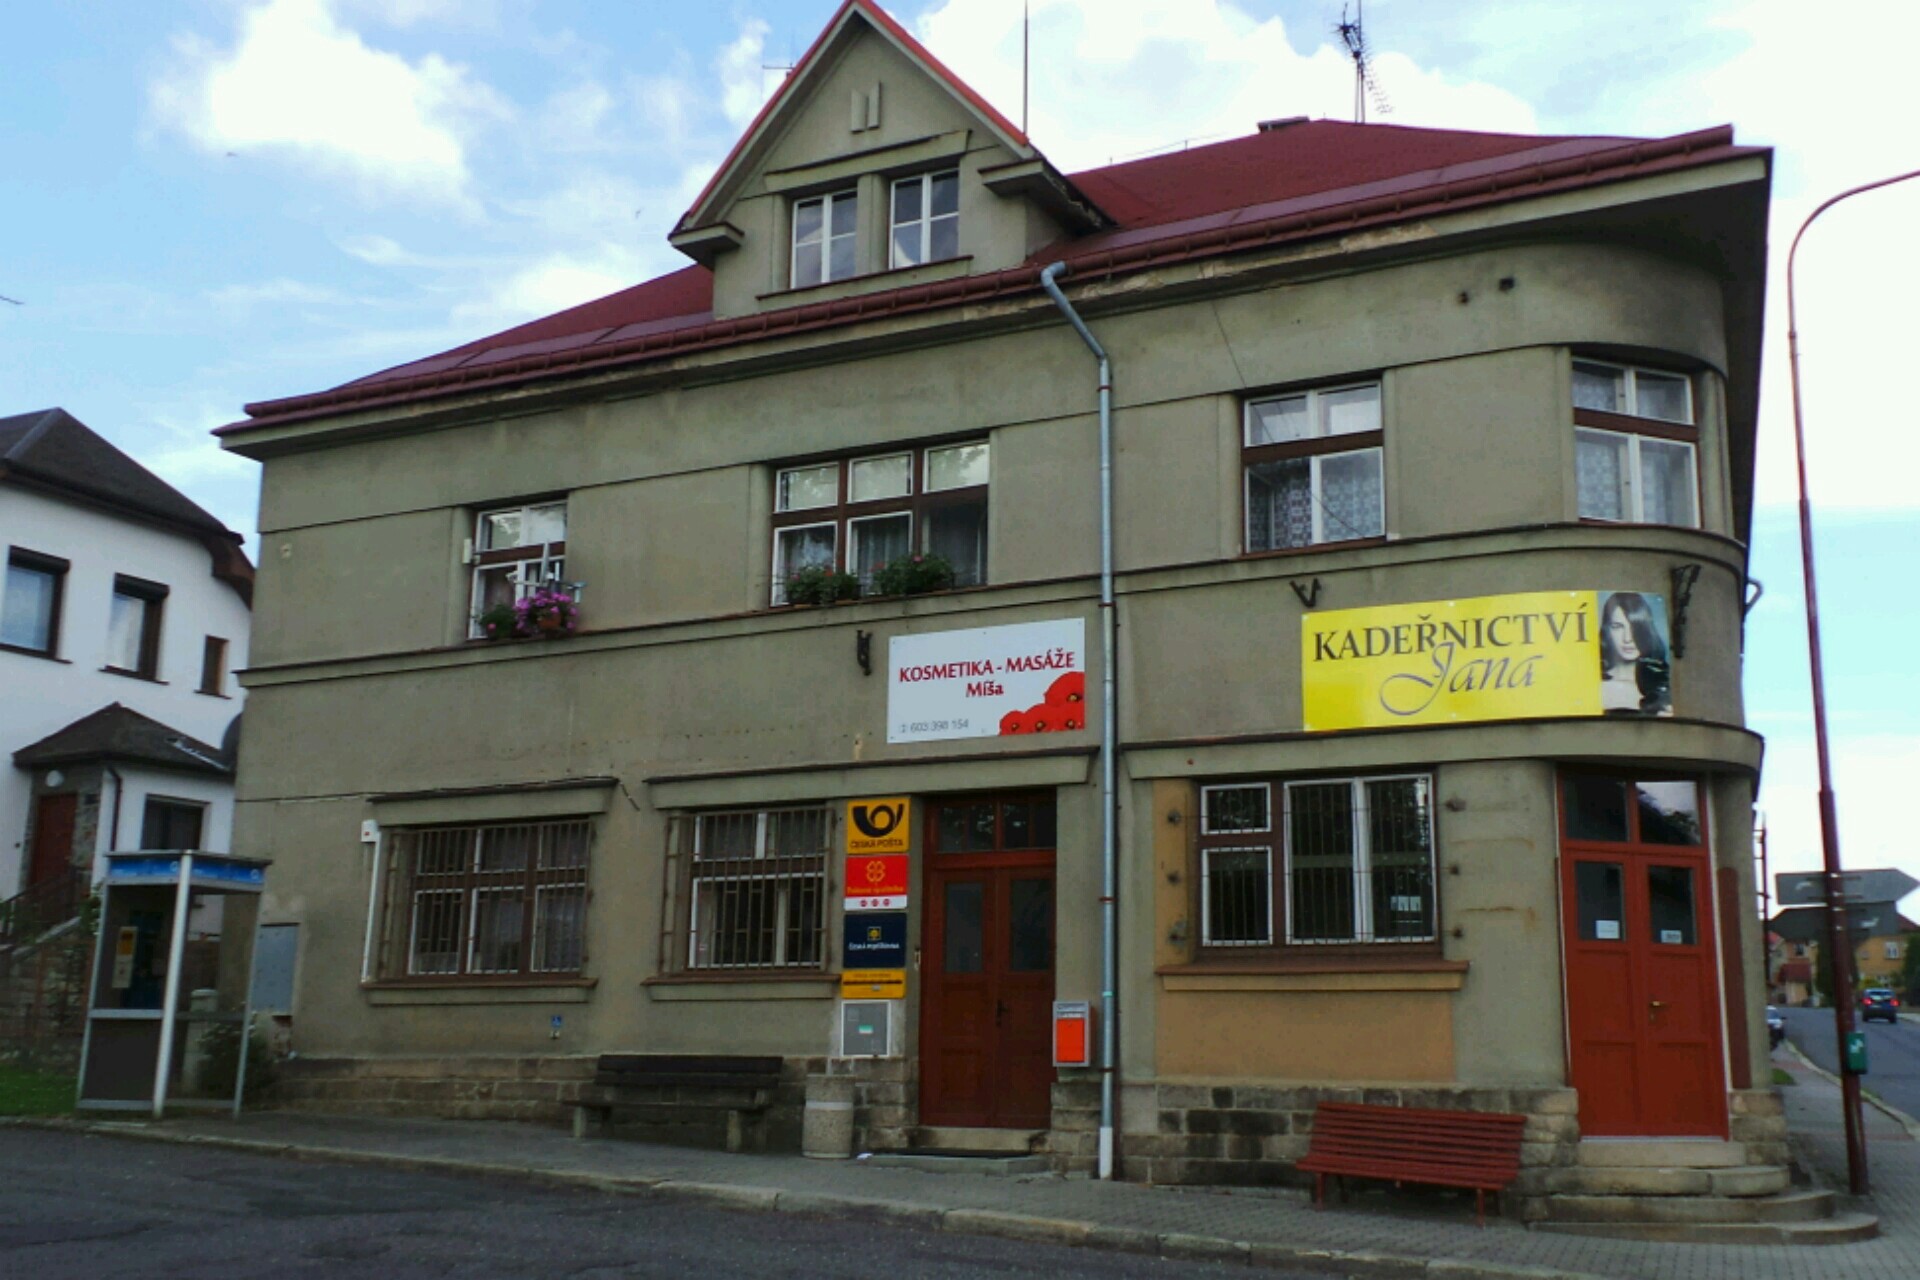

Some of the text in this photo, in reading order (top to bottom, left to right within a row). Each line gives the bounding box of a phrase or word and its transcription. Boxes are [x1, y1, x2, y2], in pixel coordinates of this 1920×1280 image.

[1313, 602, 1589, 662] KADEŘNICTVÍ
[899, 660, 994, 682] KOSMETIKA
[1006, 648, 1074, 673] MASÁŽE
[1379, 641, 1544, 716] Jana
[910, 721, 928, 733] 603
[952, 718, 969, 730] 154
